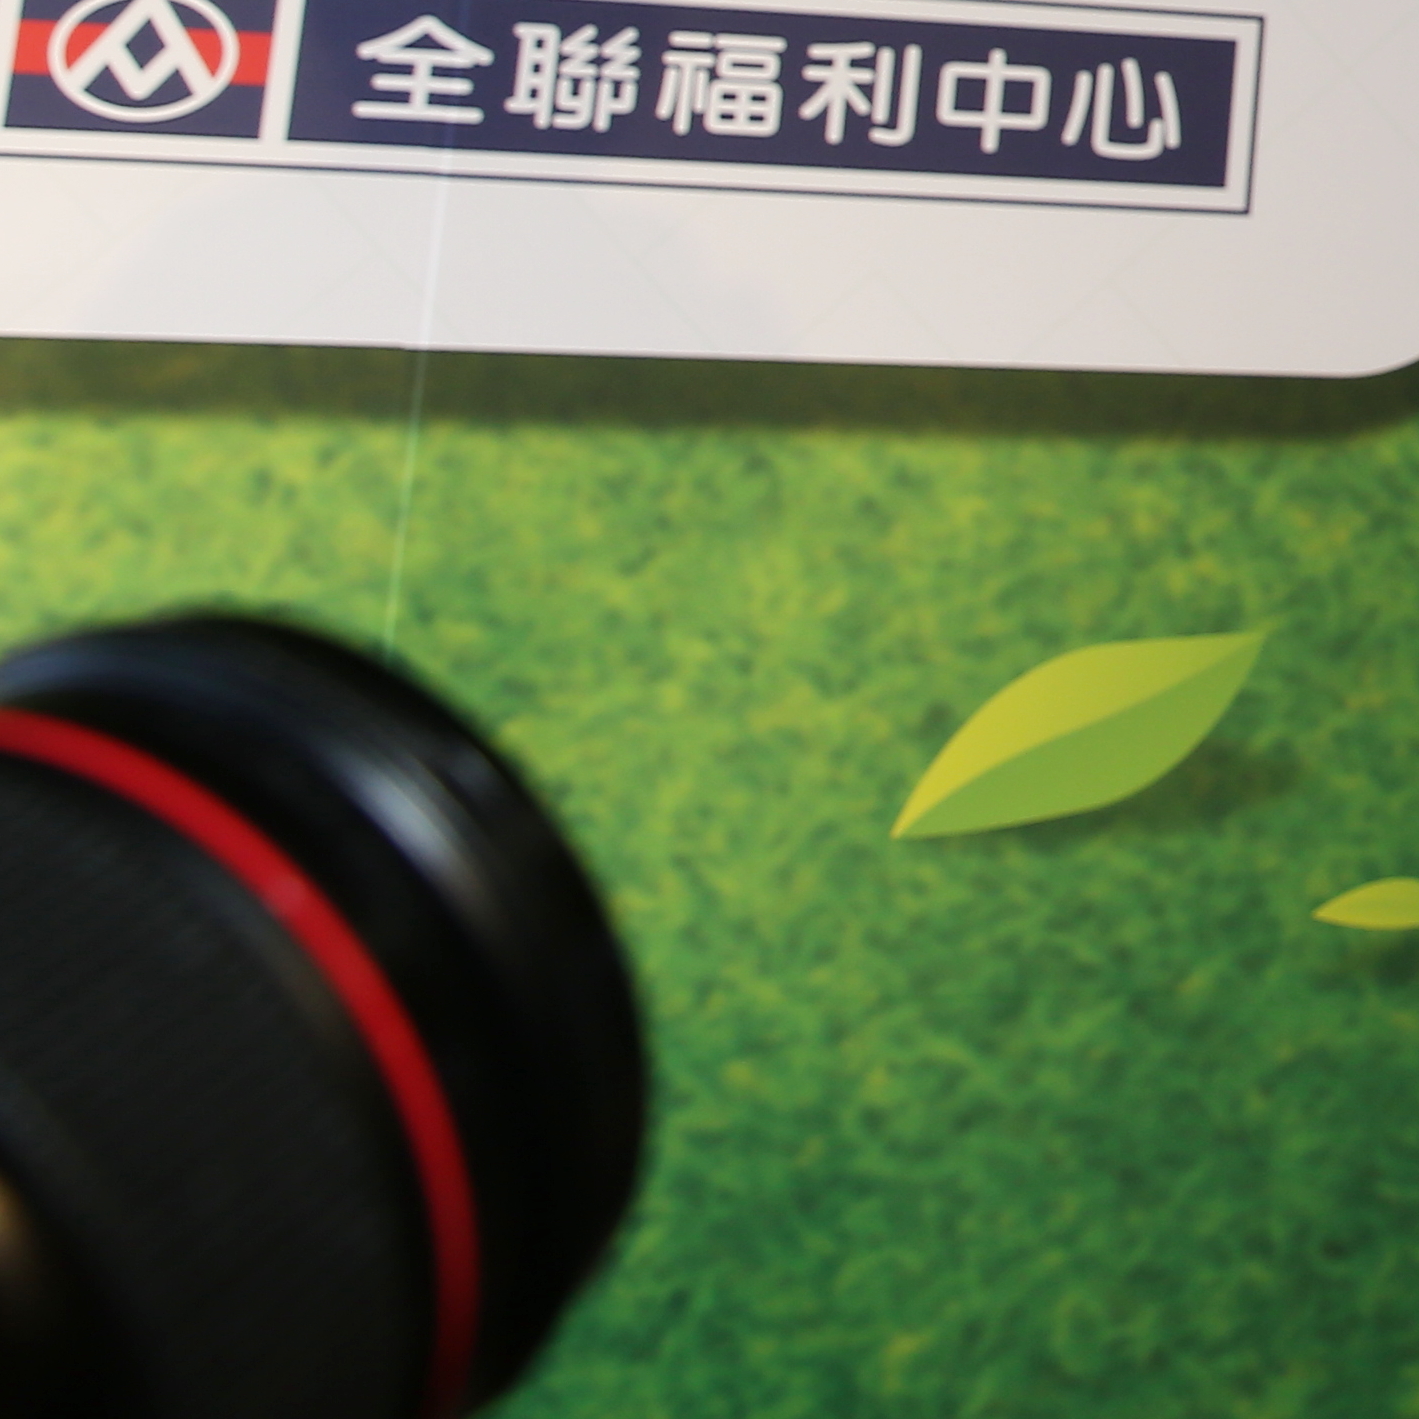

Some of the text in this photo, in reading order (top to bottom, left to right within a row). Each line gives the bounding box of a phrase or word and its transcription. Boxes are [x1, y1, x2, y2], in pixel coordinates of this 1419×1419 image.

[350, 14, 1183, 161] 全聯福利中心
